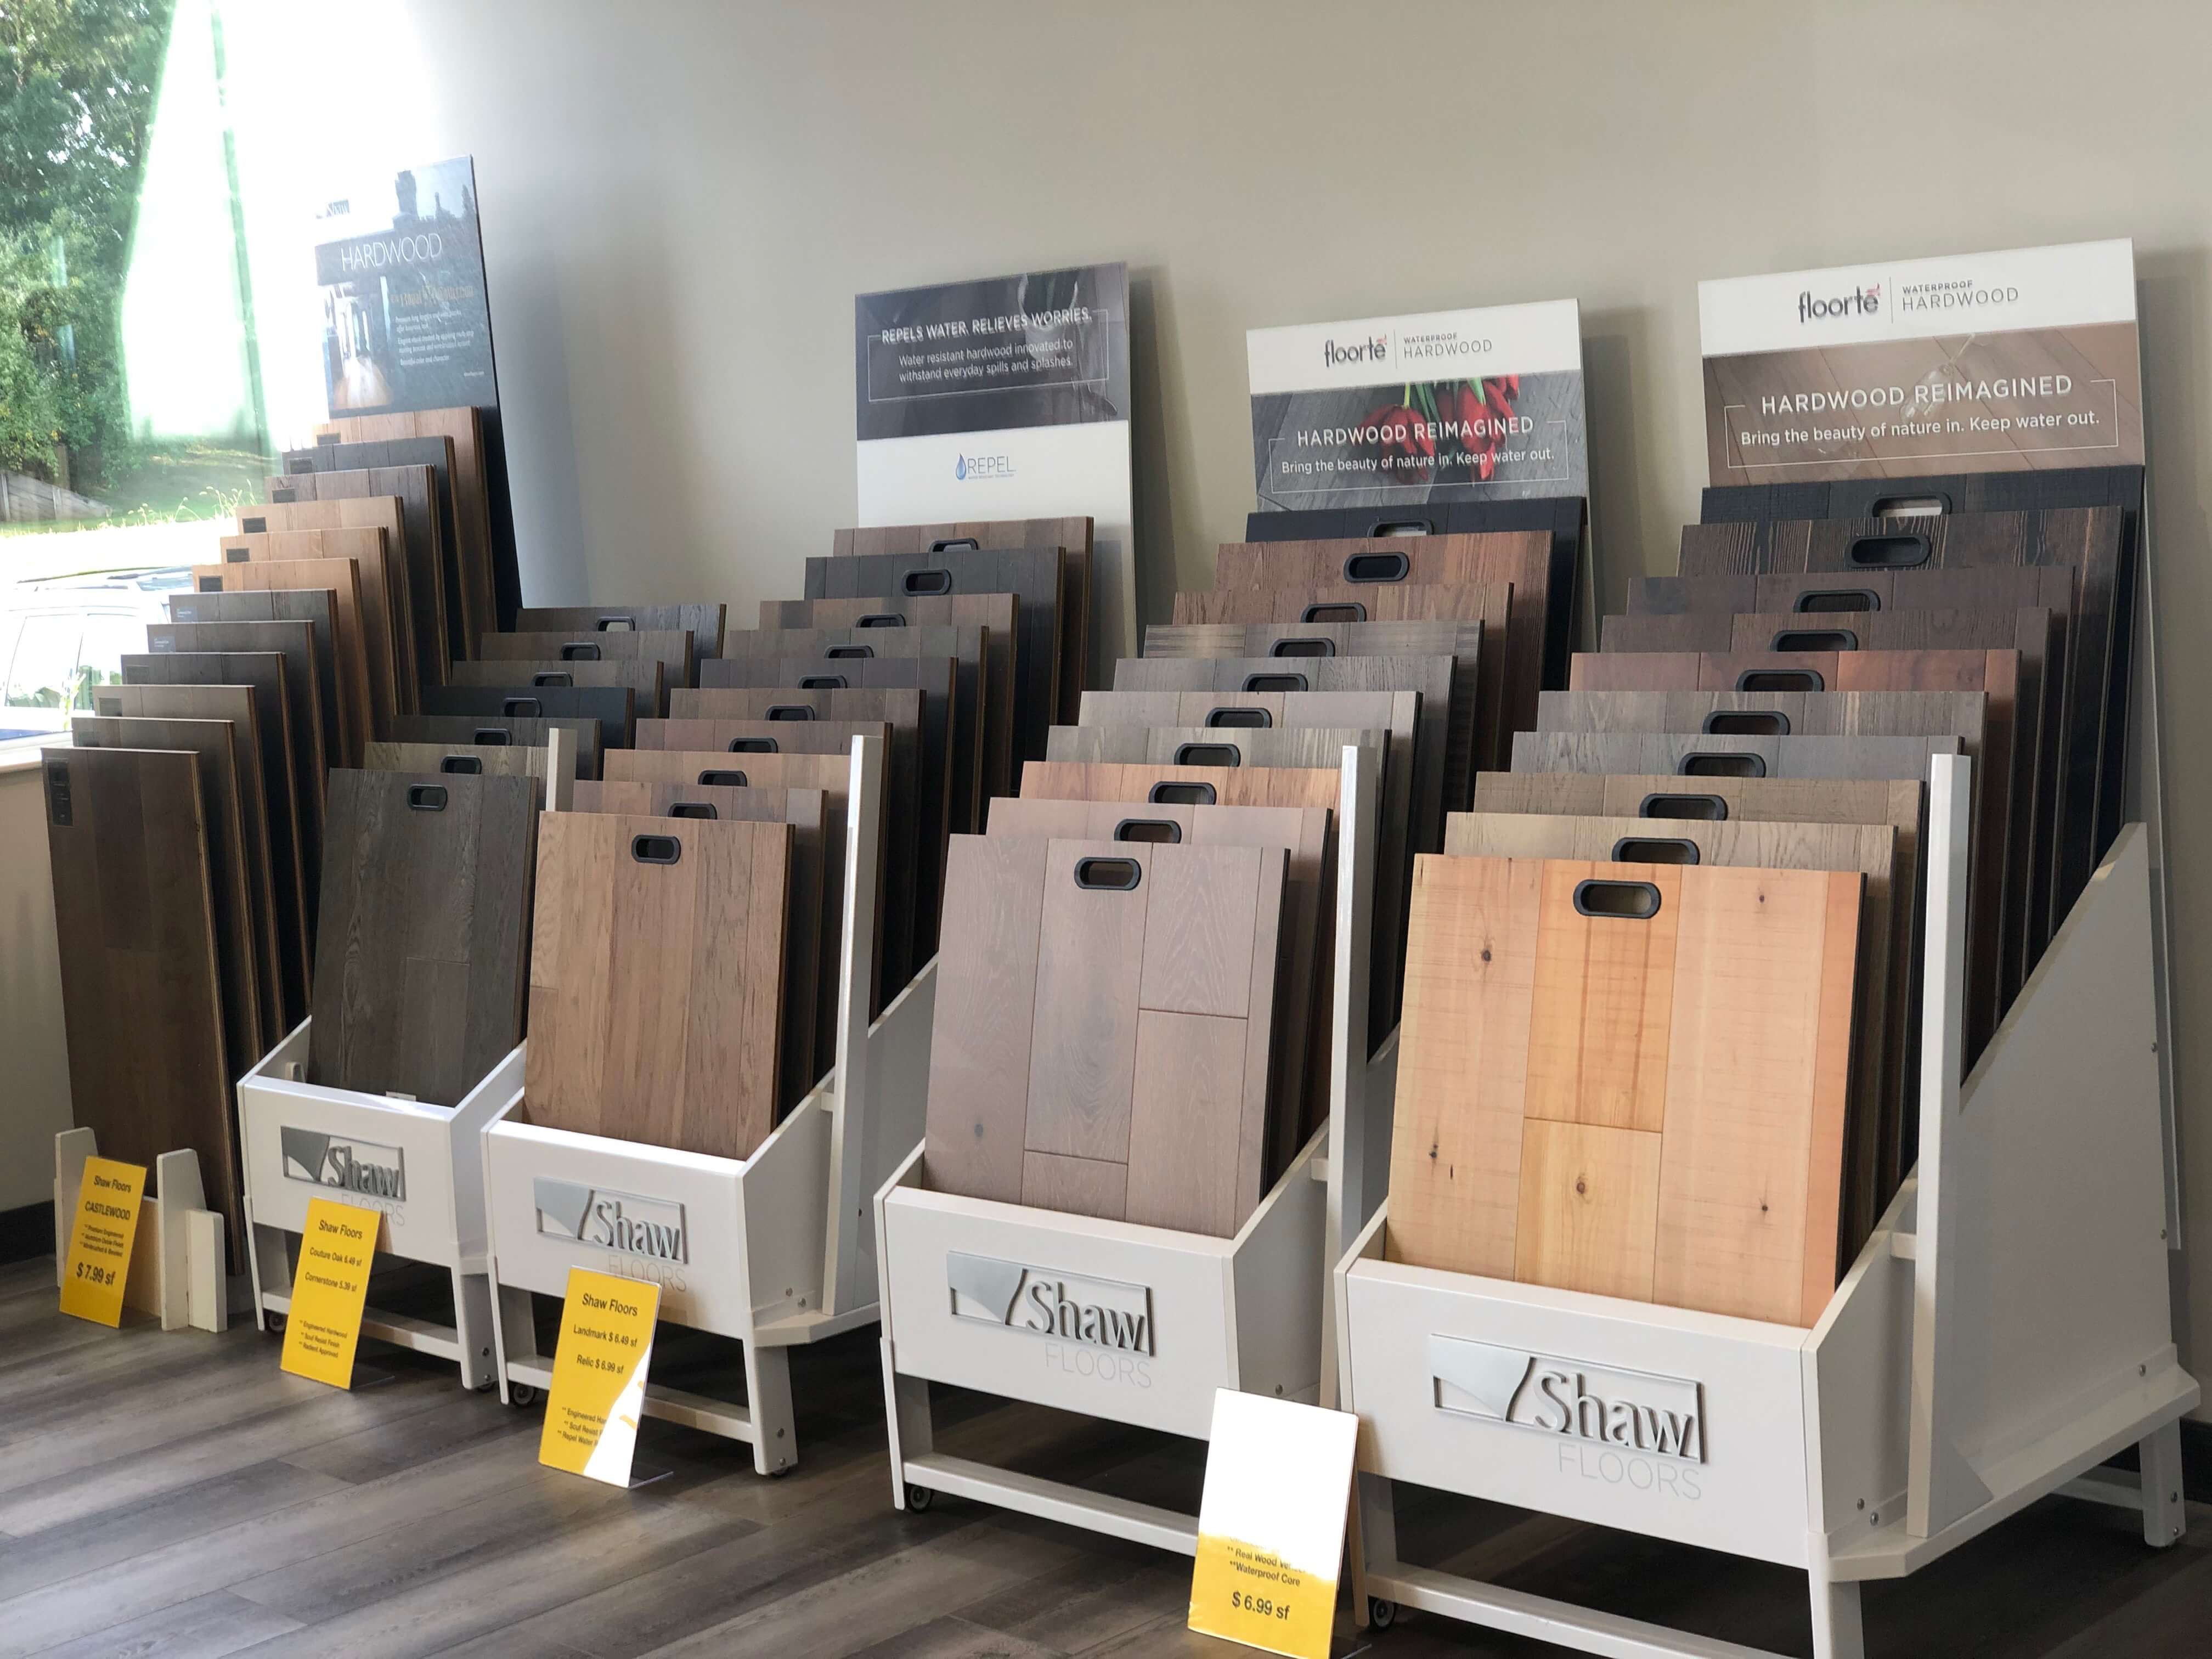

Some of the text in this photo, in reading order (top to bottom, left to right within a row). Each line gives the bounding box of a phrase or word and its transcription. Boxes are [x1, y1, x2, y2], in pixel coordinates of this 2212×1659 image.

[341, 233, 442, 272] HARDWOOD
[1902, 280, 1973, 295] WATERPROOF
[1902, 287, 2019, 312] HARDWOOD
[882, 326, 923, 344] REPELS
[972, 314, 1027, 335] RELIEVES
[1031, 307, 1092, 326] WORRIES.
[1404, 332, 1457, 344] WATERPROOF
[899, 338, 1073, 367] Water resistant hardwood innovated to
[1404, 340, 1492, 359] HARDWOOD
[899, 355, 1073, 382] withstand everyday spills and splashes.
[1760, 375, 2073, 416] HARDWOOD REIMAGINED
[1297, 416, 1534, 448] HARDWOOD REIMAGINED
[1741, 410, 2100, 448] Bring the beauty of nature in. Keep water out.
[968, 456, 1016, 474] REPEL
[1282, 447, 1555, 475] Bring the beauty of nature in. Keep water out.
[94, 1175, 132, 1194] Shaw Floors
[328, 1146, 400, 1198] Shaw
[84, 1200, 131, 1221] CASTLEWOOD
[319, 1219, 363, 1239] Shaw Floors
[592, 1200, 680, 1261] Shaw
[310, 1246, 331, 1260] Couture
[332, 1252, 343, 1262] Oak
[76, 1262, 116, 1286] $ 7.99 sf
[305, 1272, 338, 1288] Cornerstone
[582, 1292, 638, 1317] Shaw Floors
[1025, 1280, 1147, 1352] Shaw
[573, 1323, 637, 1347] Landmark $ 6.49 sf
[577, 1353, 624, 1374] Relic $ 6.99 sf
[1045, 1342, 1152, 1388] FLOORS
[567, 1408, 596, 1422] Engineered
[1533, 1370, 1699, 1460] Shaw
[1558, 1442, 1701, 1501] FLOORS
[1235, 1548, 1252, 1560] Real
[1255, 1553, 1277, 1567] Wood
[1281, 1573, 1301, 1587] Core
[1232, 1590, 1290, 1621] $ 6.99 sf
